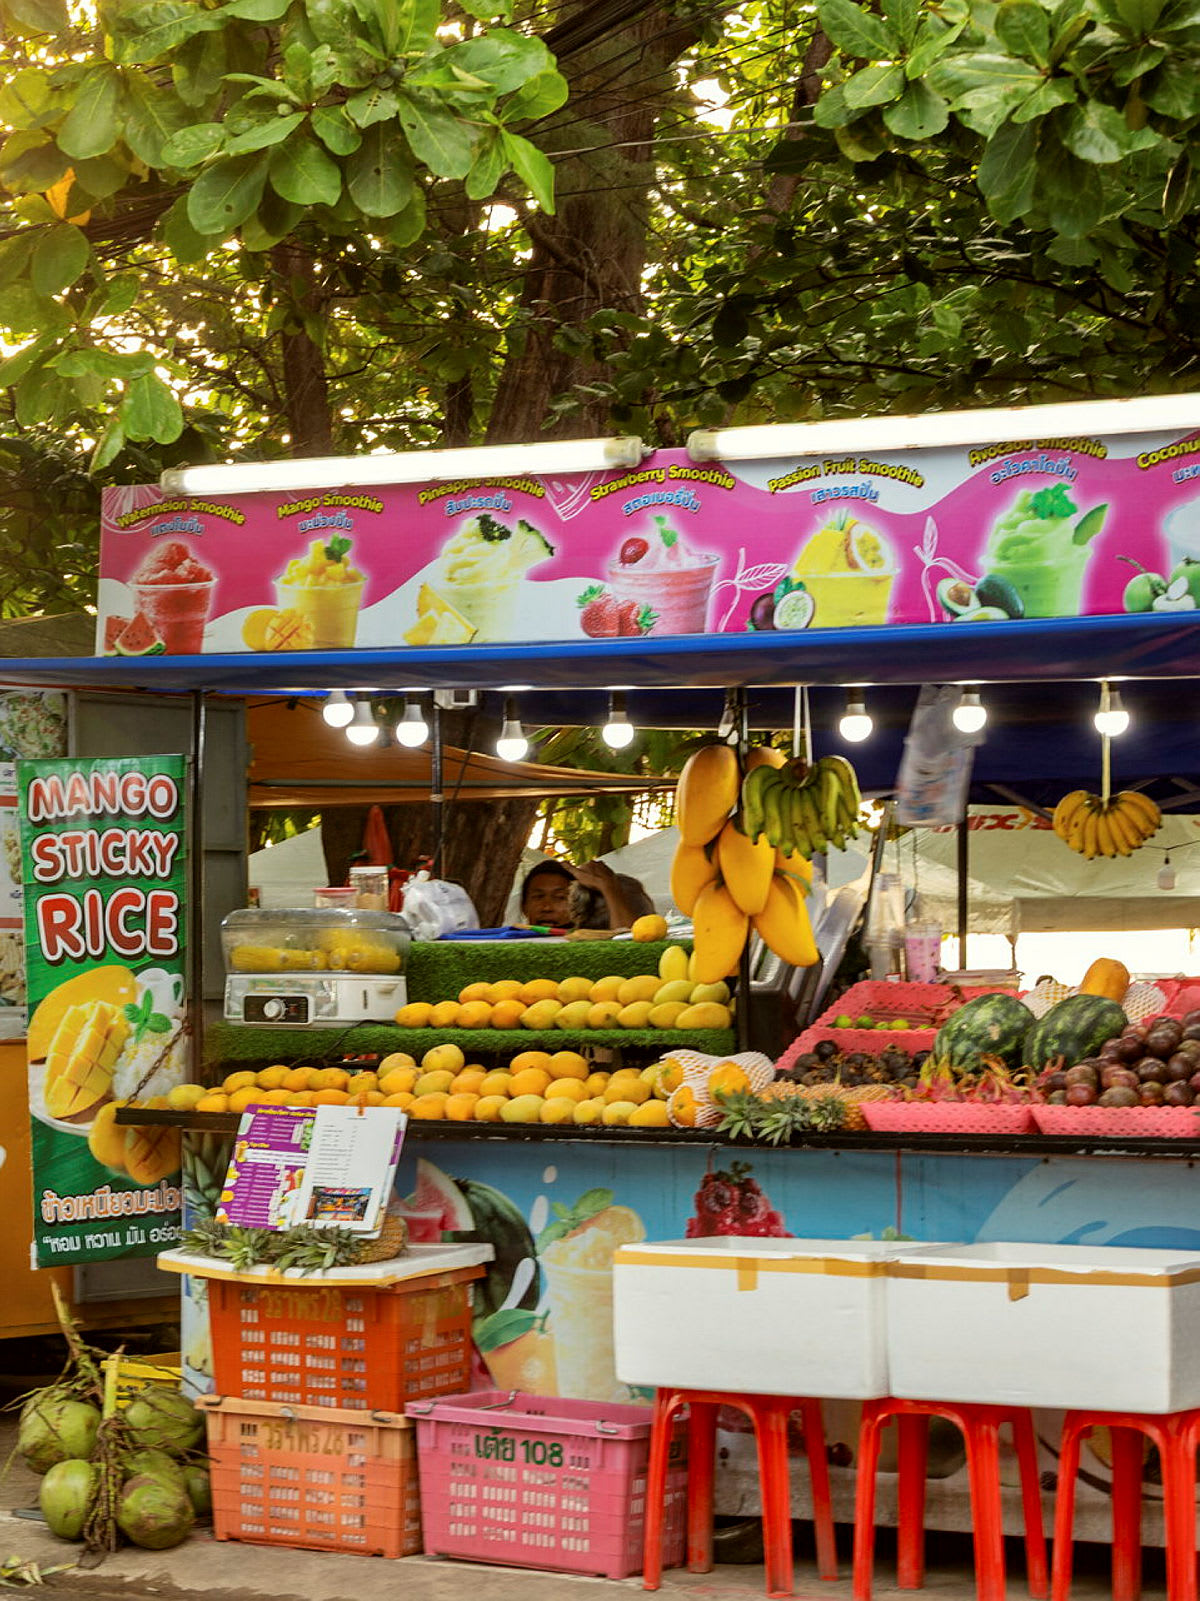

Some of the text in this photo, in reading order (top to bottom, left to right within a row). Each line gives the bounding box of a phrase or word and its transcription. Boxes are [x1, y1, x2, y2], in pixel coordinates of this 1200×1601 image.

[589, 464, 736, 500] Strawberry Smoothie
[767, 457, 925, 493] Passion Fruit Smoothie
[115, 499, 246, 528] Watermelon Smoothie
[277, 493, 384, 520] Mango Smoothie
[28, 771, 177, 823] MANGO
[32, 828, 177, 882] STICKY
[38, 888, 177, 961] RICE
[41, 1180, 183, 1223] ข้าวเหนียวมะม่ว
[519, 1440, 563, 1467] 108
